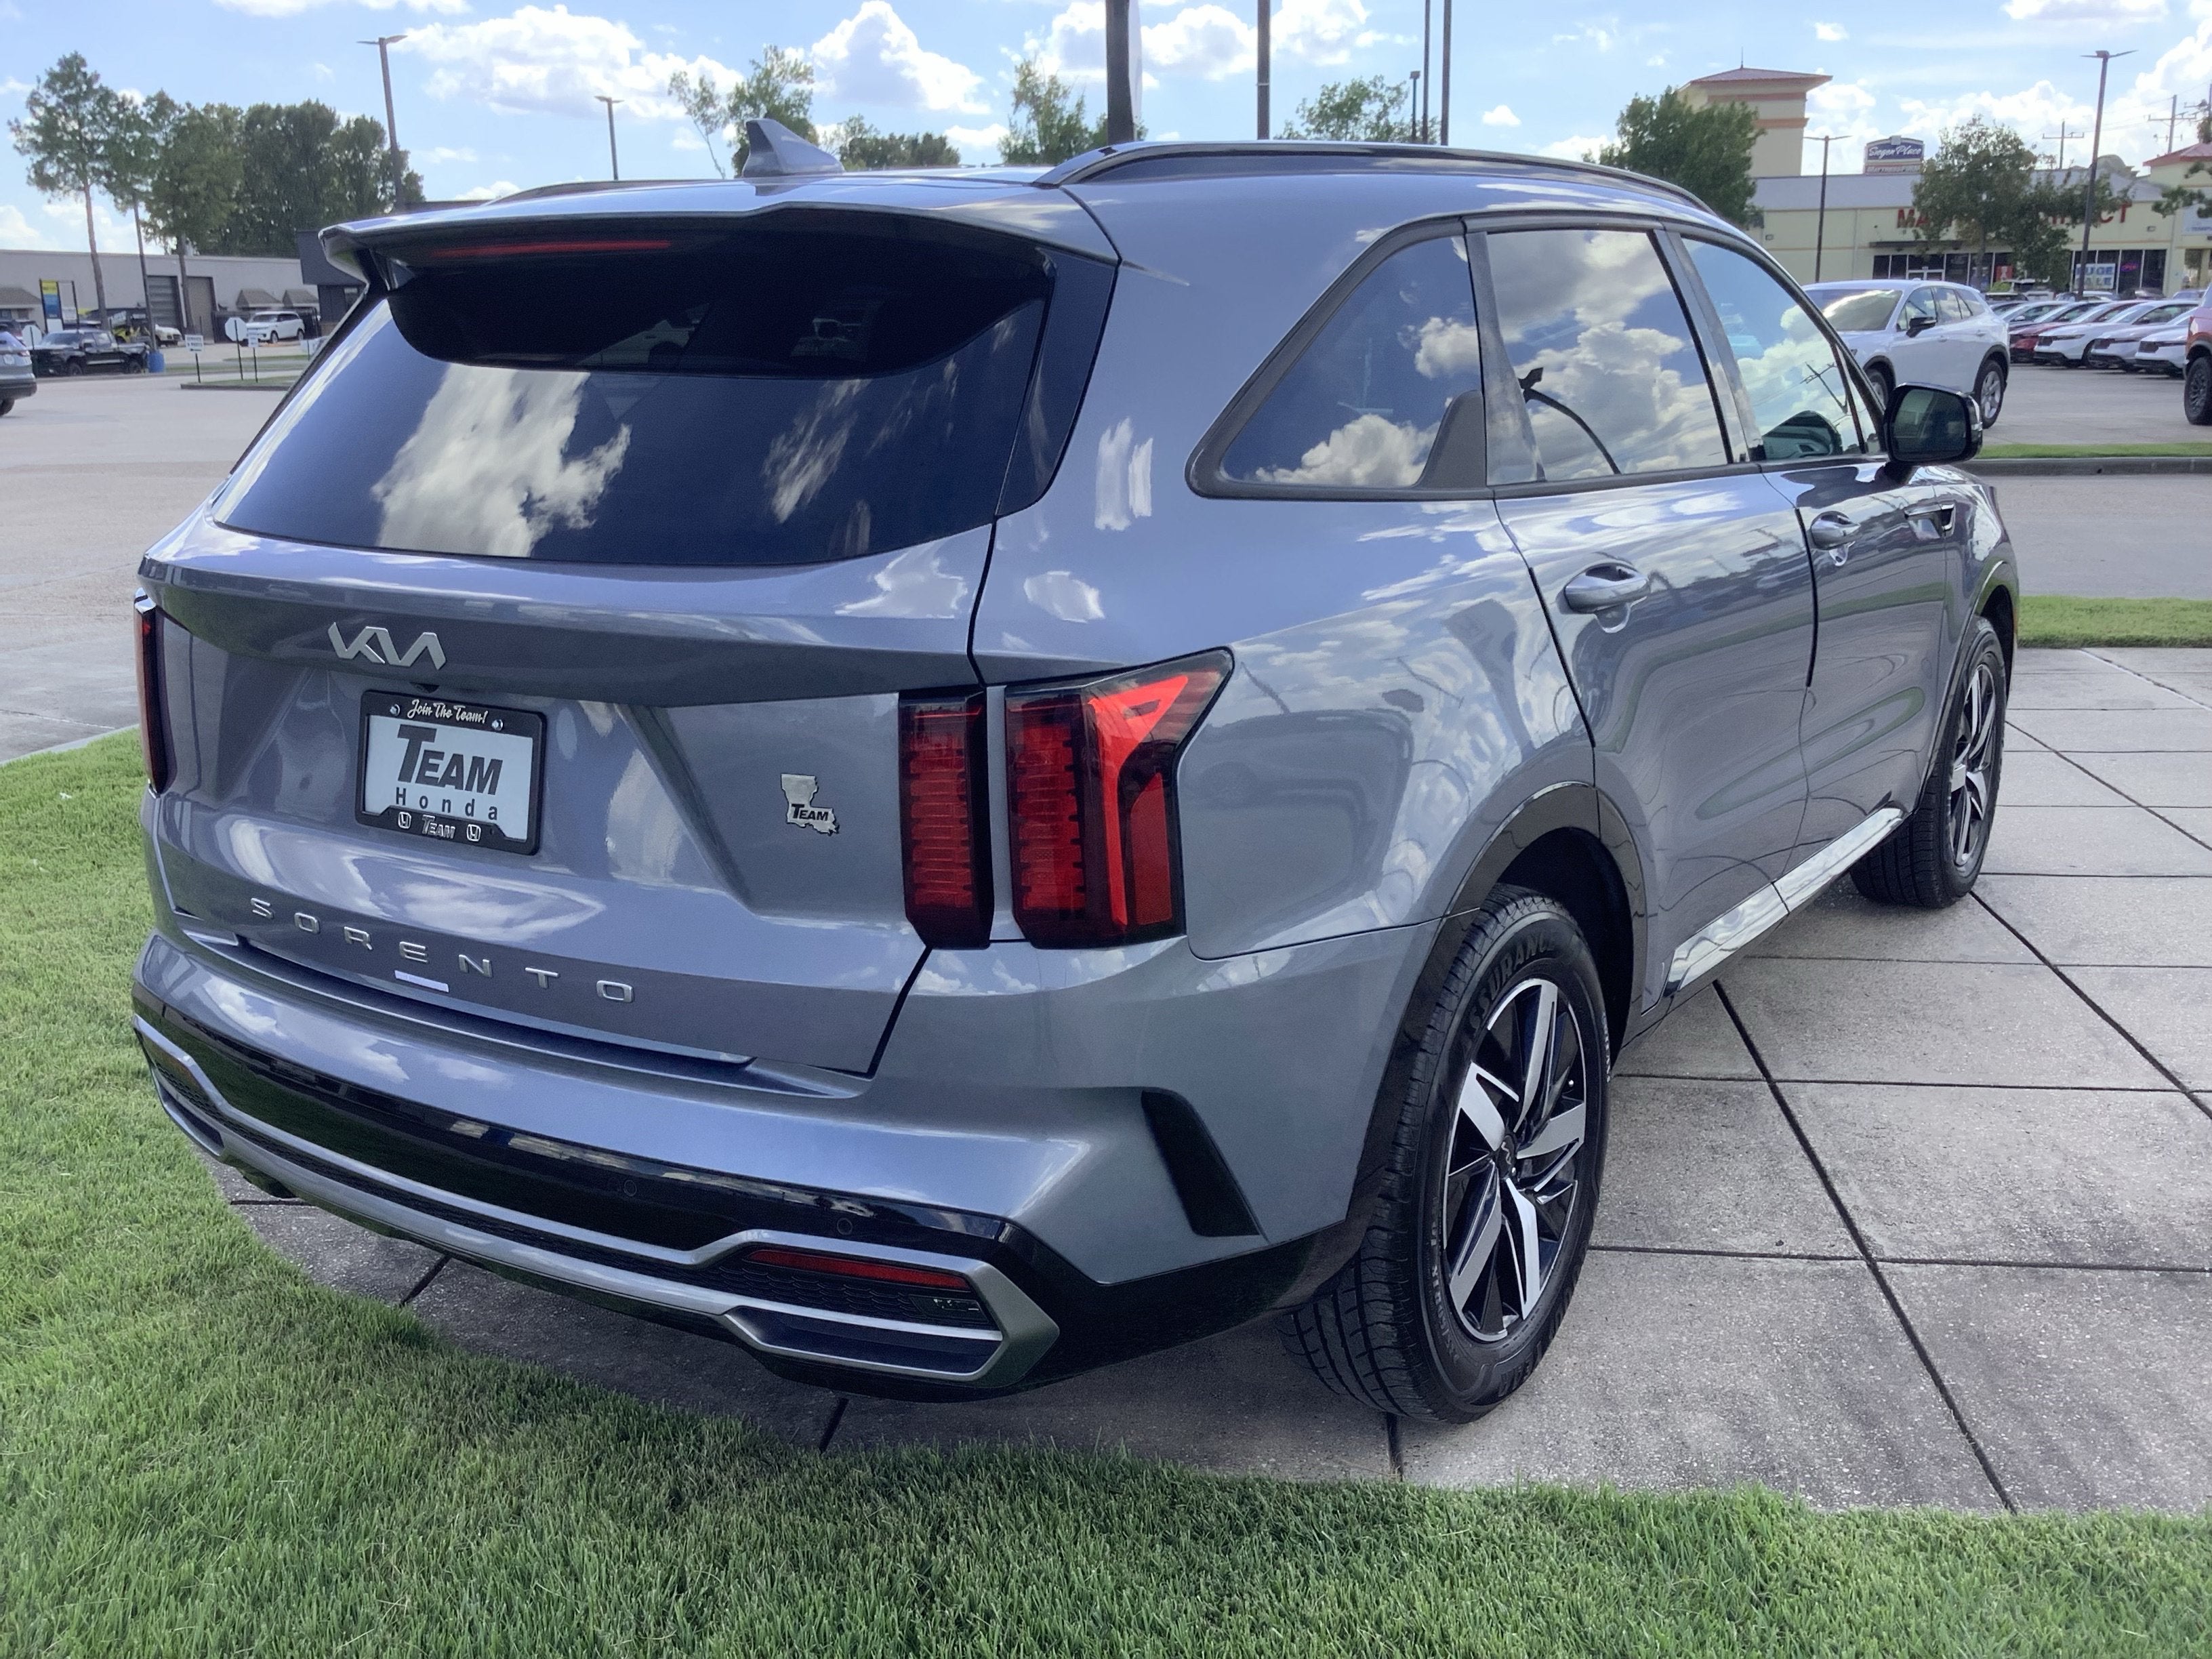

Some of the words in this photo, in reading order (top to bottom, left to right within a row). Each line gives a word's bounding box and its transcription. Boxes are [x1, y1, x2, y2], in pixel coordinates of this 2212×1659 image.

[407, 699, 433, 719] Join
[433, 702, 453, 719] The
[453, 705, 489, 724] Team!
[396, 724, 503, 796] TEAM
[396, 787, 498, 821] Honda
[791, 803, 829, 821] TEAM
[422, 814, 456, 840] TEAM
[250, 897, 635, 1004] SORENTO
